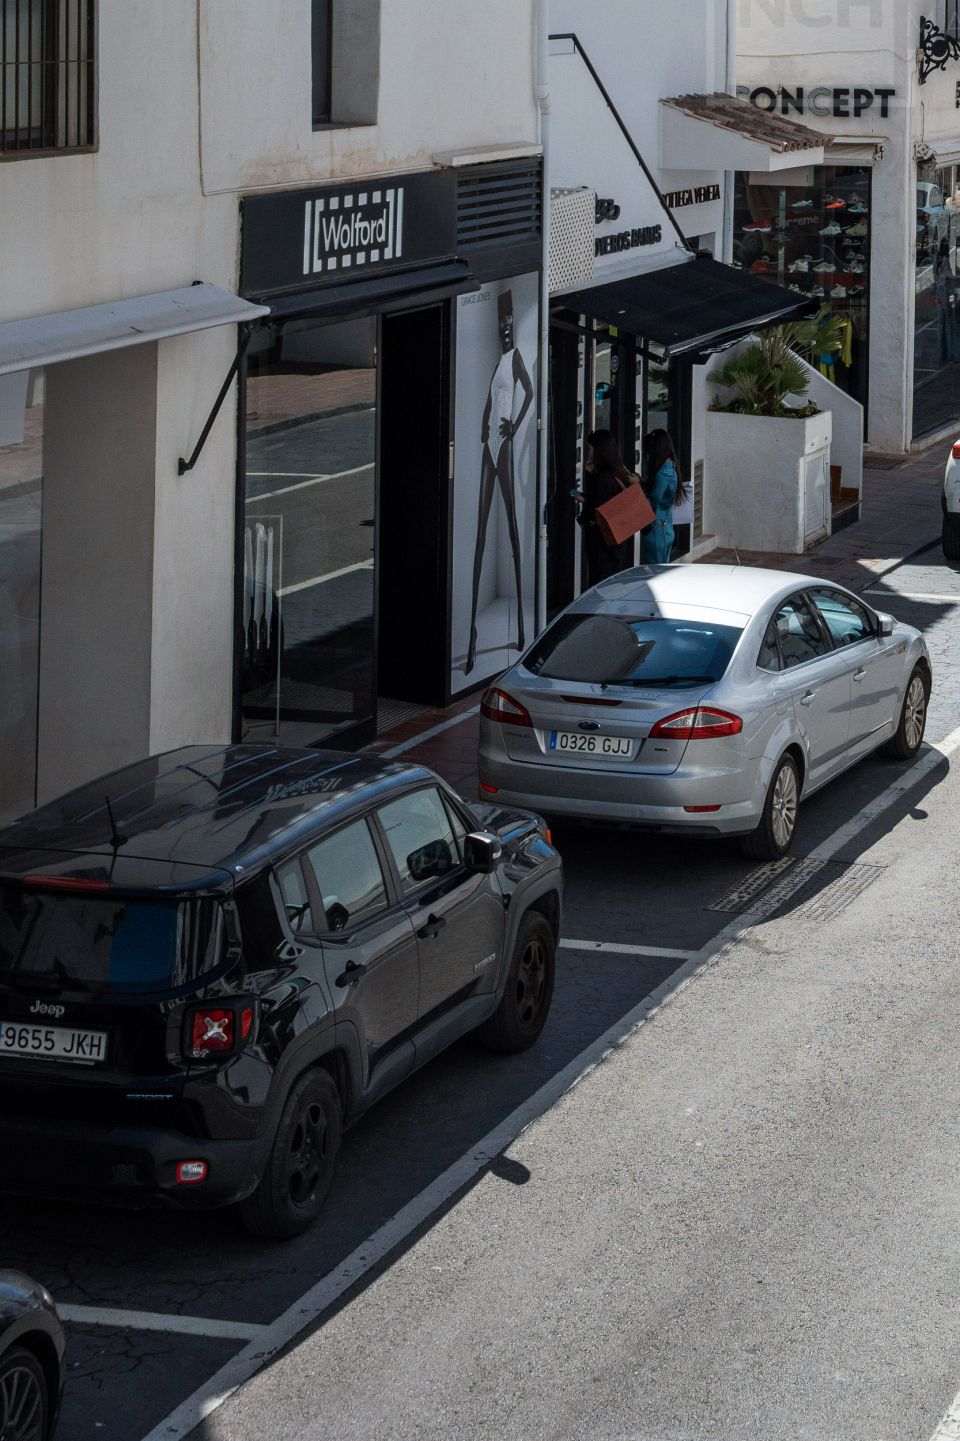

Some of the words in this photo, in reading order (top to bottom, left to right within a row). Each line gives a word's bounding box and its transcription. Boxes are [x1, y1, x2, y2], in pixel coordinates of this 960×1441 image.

[321, 208, 387, 252] Wolford
[560, 734, 596, 752] 0326
[602, 738, 631, 755] GJJ
[29, 1000, 65, 1019] Jeep
[4, 1026, 56, 1051] 9655
[63, 1032, 103, 1057] JKH
